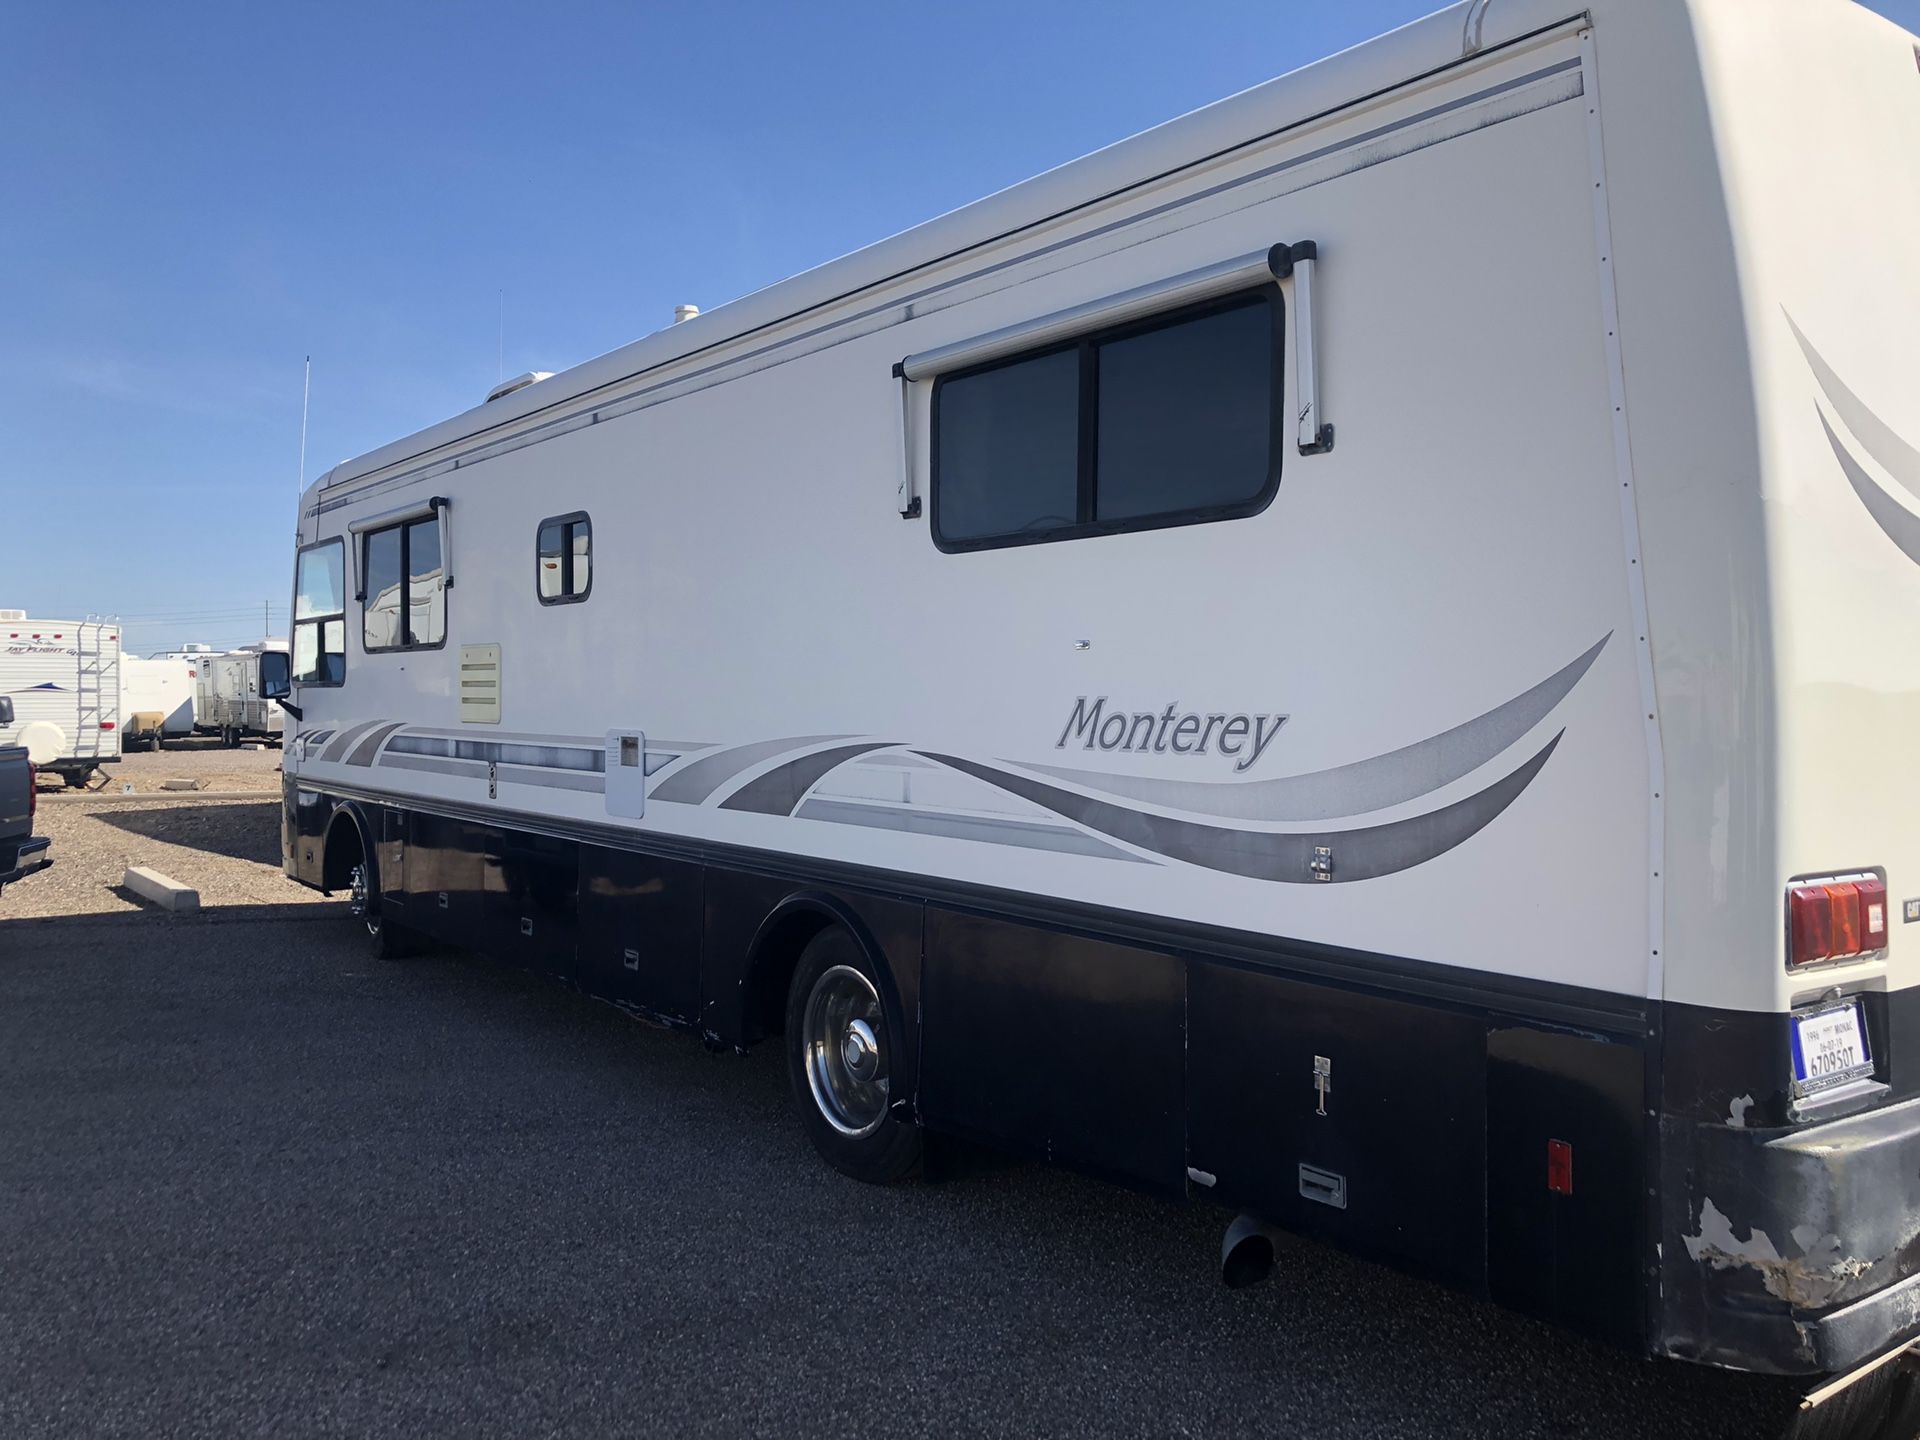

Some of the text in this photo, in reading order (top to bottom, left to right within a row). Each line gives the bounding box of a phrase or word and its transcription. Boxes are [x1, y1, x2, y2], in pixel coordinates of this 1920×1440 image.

[26, 645, 65, 653] FLIGHT
[1056, 696, 1290, 772] Monterey
[1810, 1046, 1856, 1077] 670950T
